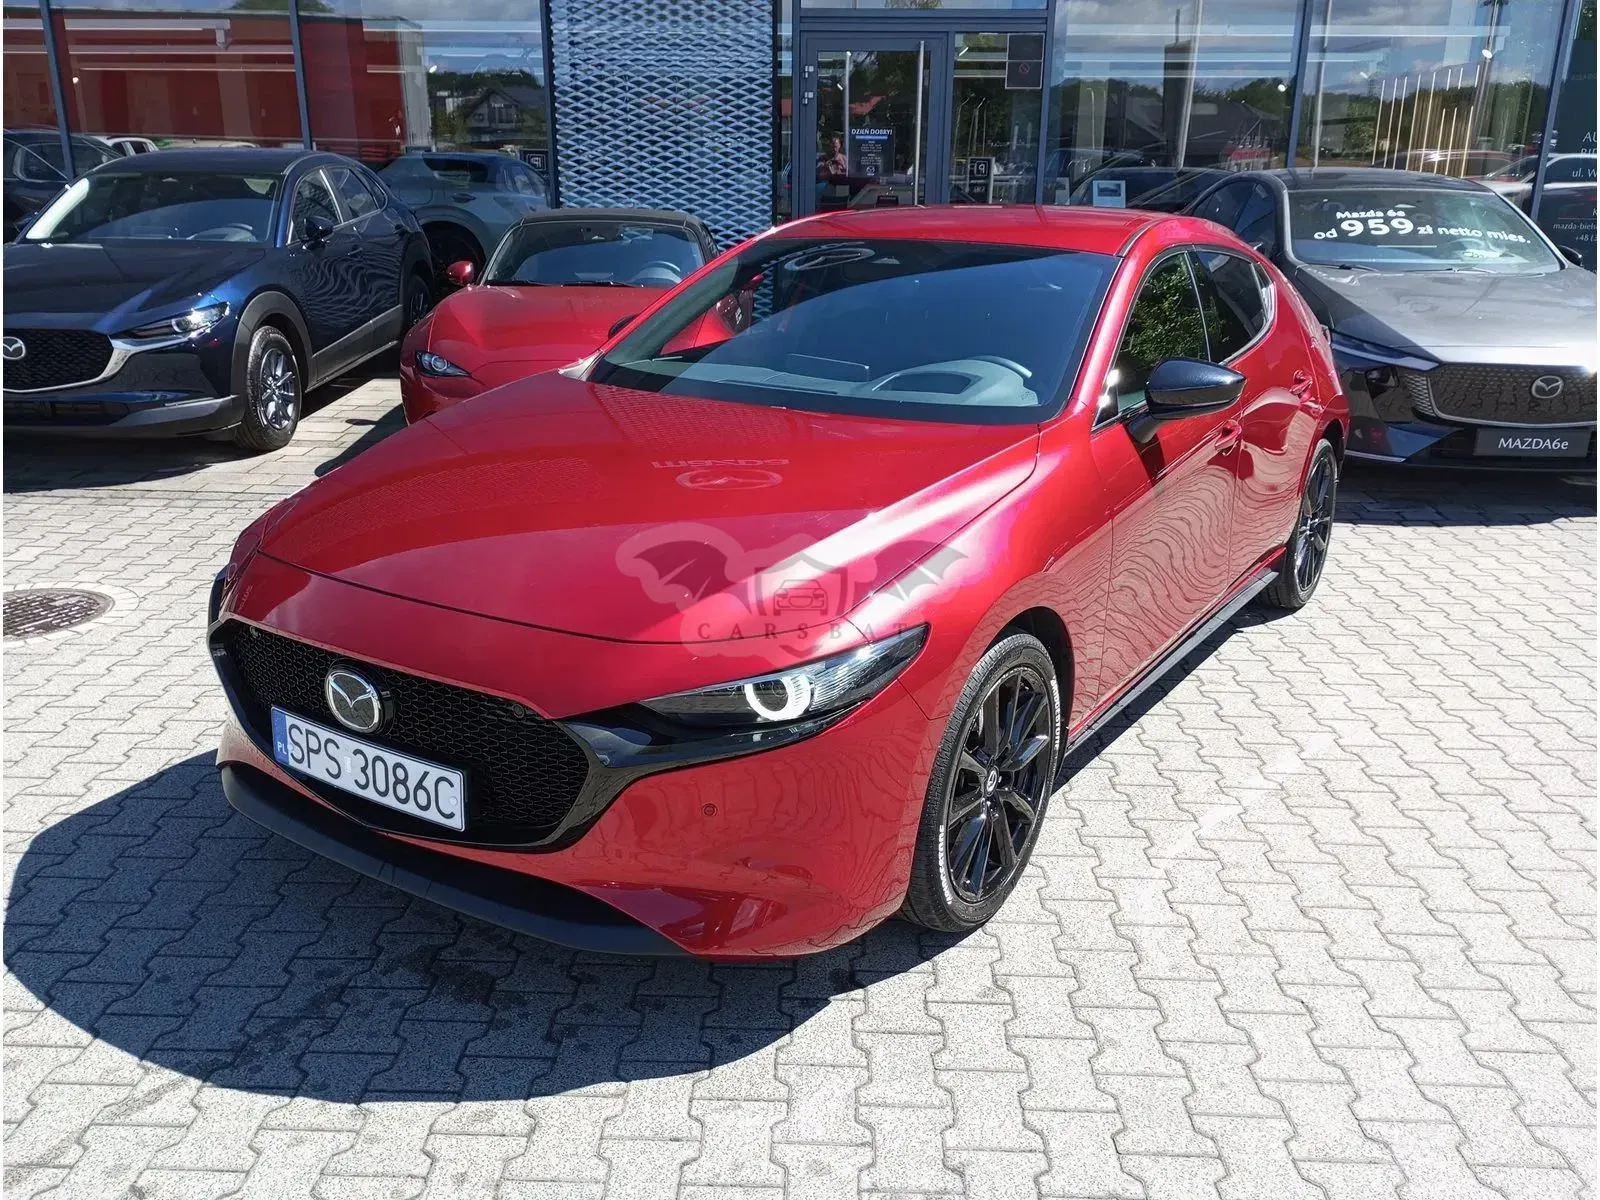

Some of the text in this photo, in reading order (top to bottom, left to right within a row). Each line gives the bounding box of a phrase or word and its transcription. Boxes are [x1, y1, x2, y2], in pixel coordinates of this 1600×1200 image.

[1336, 209, 1406, 219] Mazda 6e
[1314, 228, 1338, 239] od
[1341, 218, 1414, 236] 959
[1438, 227, 1482, 237] netto
[1487, 231, 1531, 243] mies.
[1498, 438, 1569, 449] MAZDA6e
[277, 724, 456, 819] PL SPS 3086C
